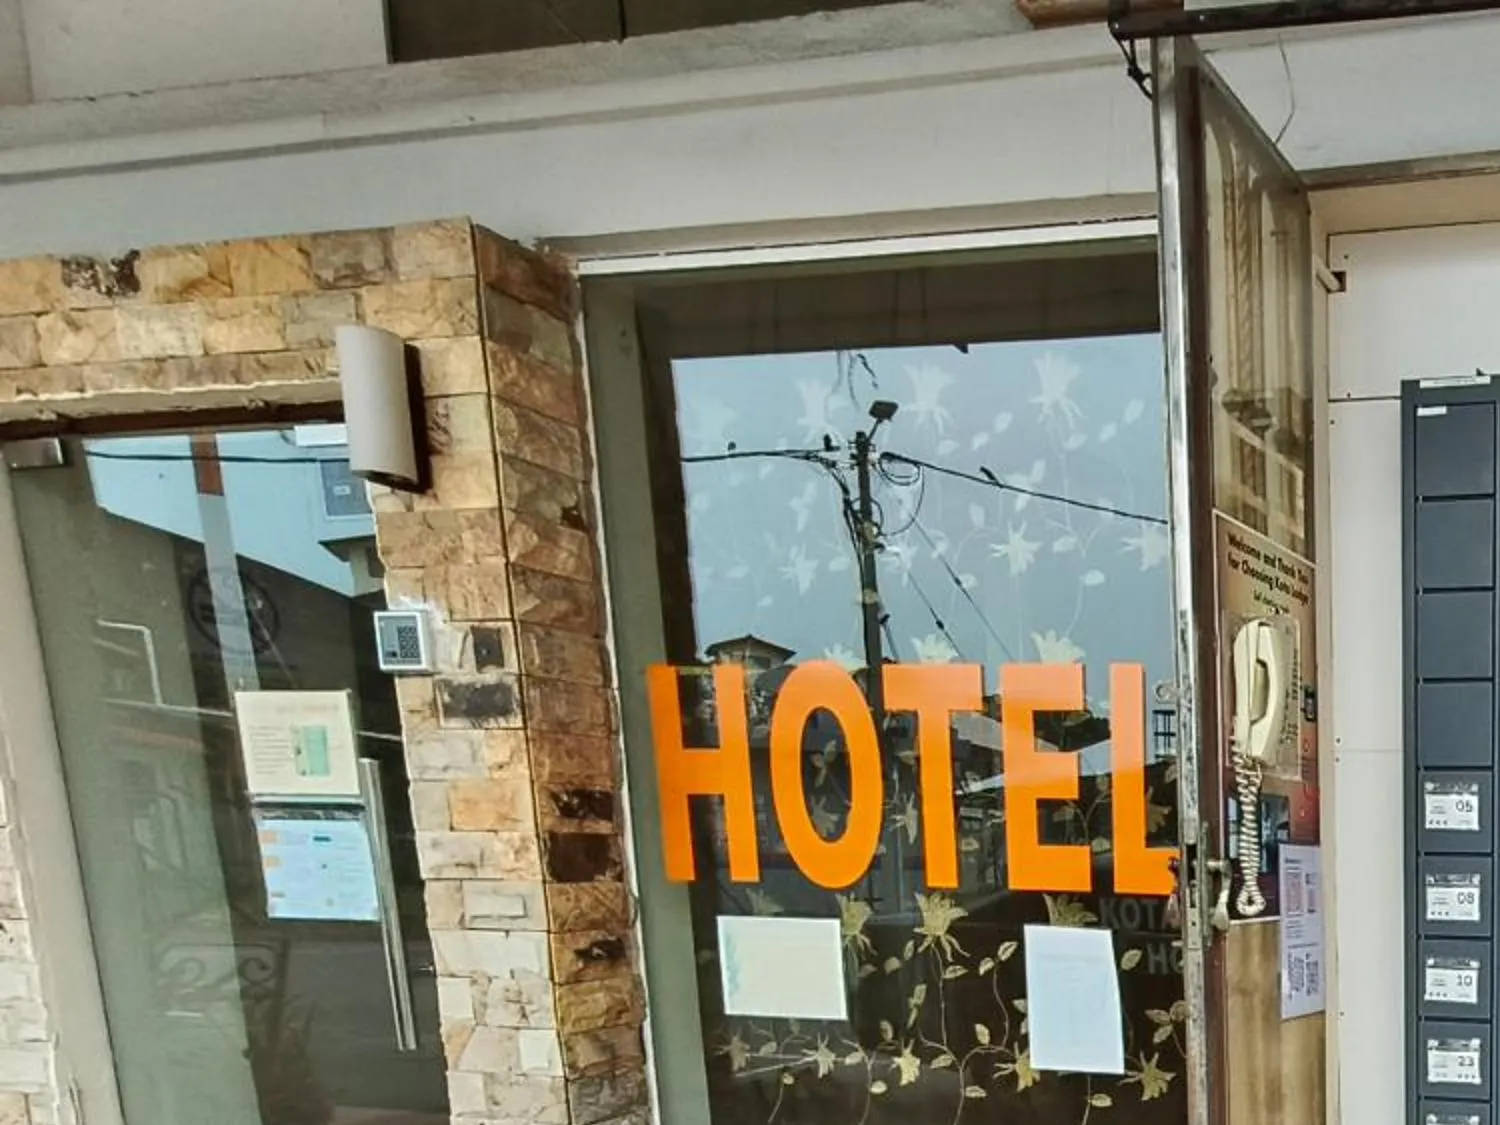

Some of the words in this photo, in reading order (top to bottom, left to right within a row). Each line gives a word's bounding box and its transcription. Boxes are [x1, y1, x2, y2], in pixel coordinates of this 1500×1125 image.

[646, 658, 1179, 894] HOTEL
[1455, 800, 1473, 813] 05
[1457, 974, 1473, 987] 10
